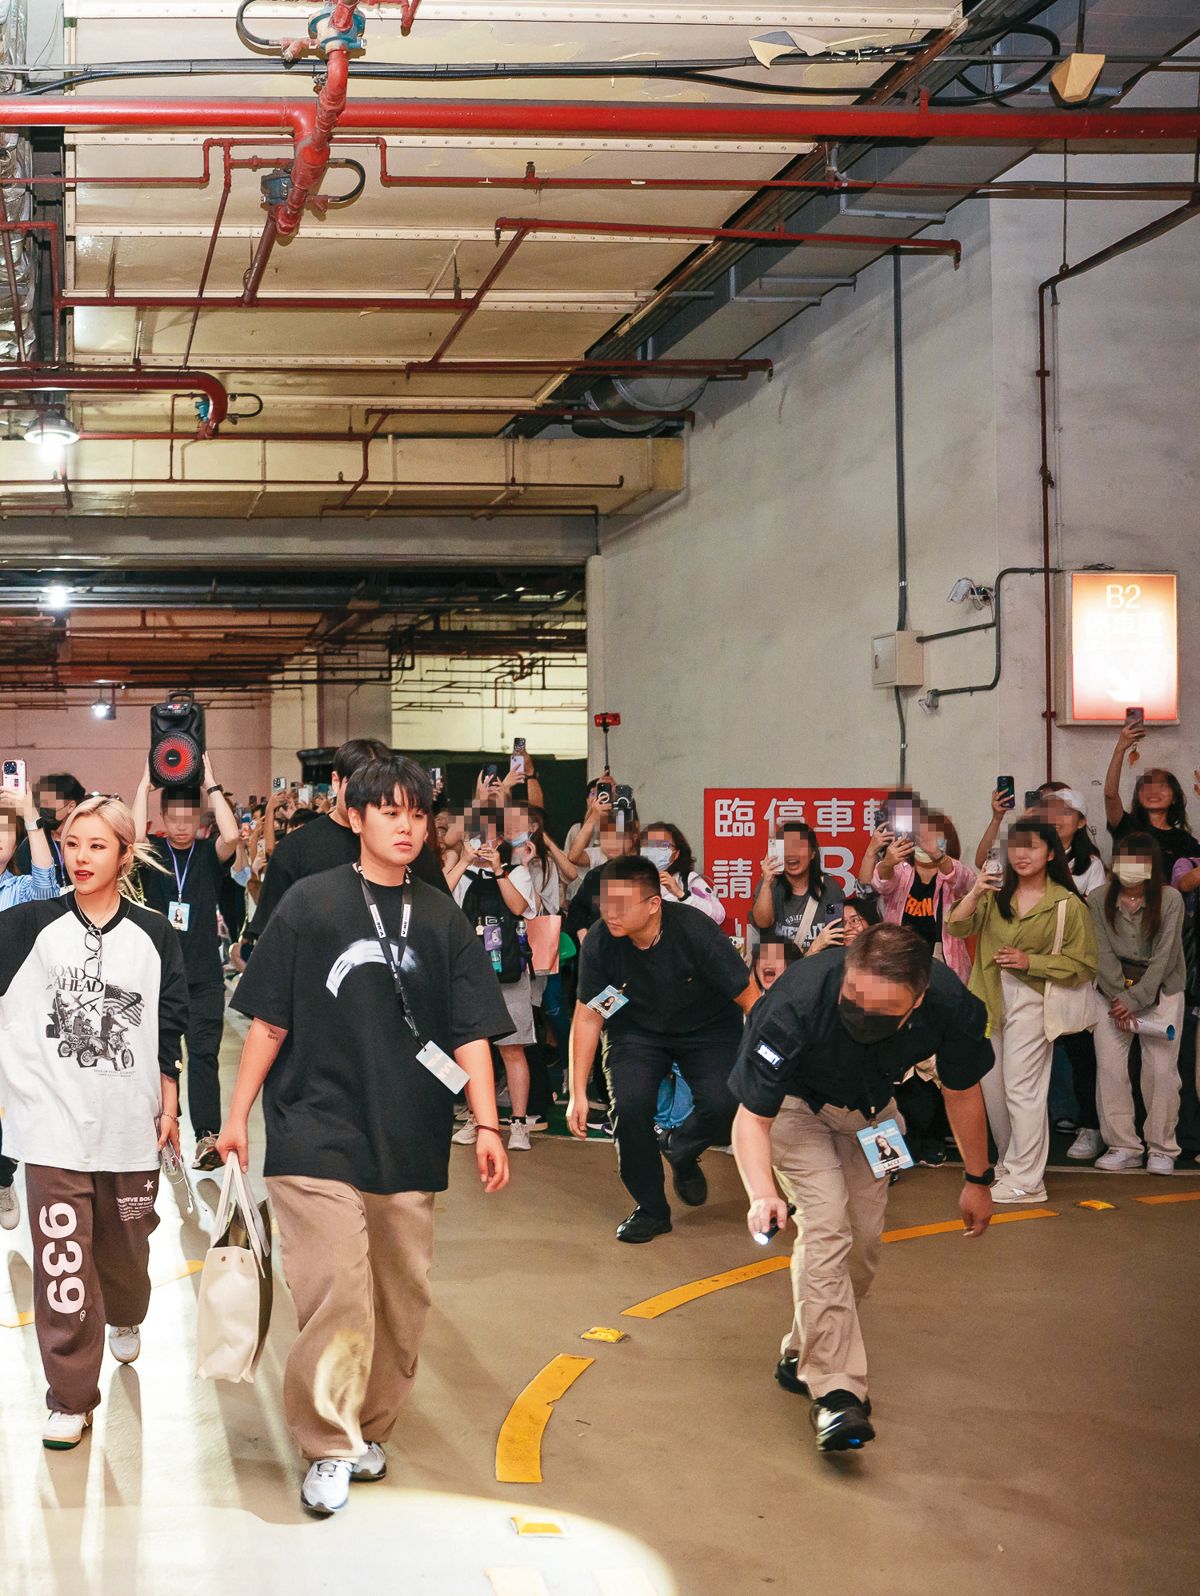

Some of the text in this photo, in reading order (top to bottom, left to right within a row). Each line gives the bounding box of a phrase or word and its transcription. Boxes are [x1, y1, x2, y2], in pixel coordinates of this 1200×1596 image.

[1106, 584, 1142, 609] B2
[47, 965, 86, 980] ROAD
[54, 976, 104, 993] AHEAD
[38, 1202, 86, 1314] 939
